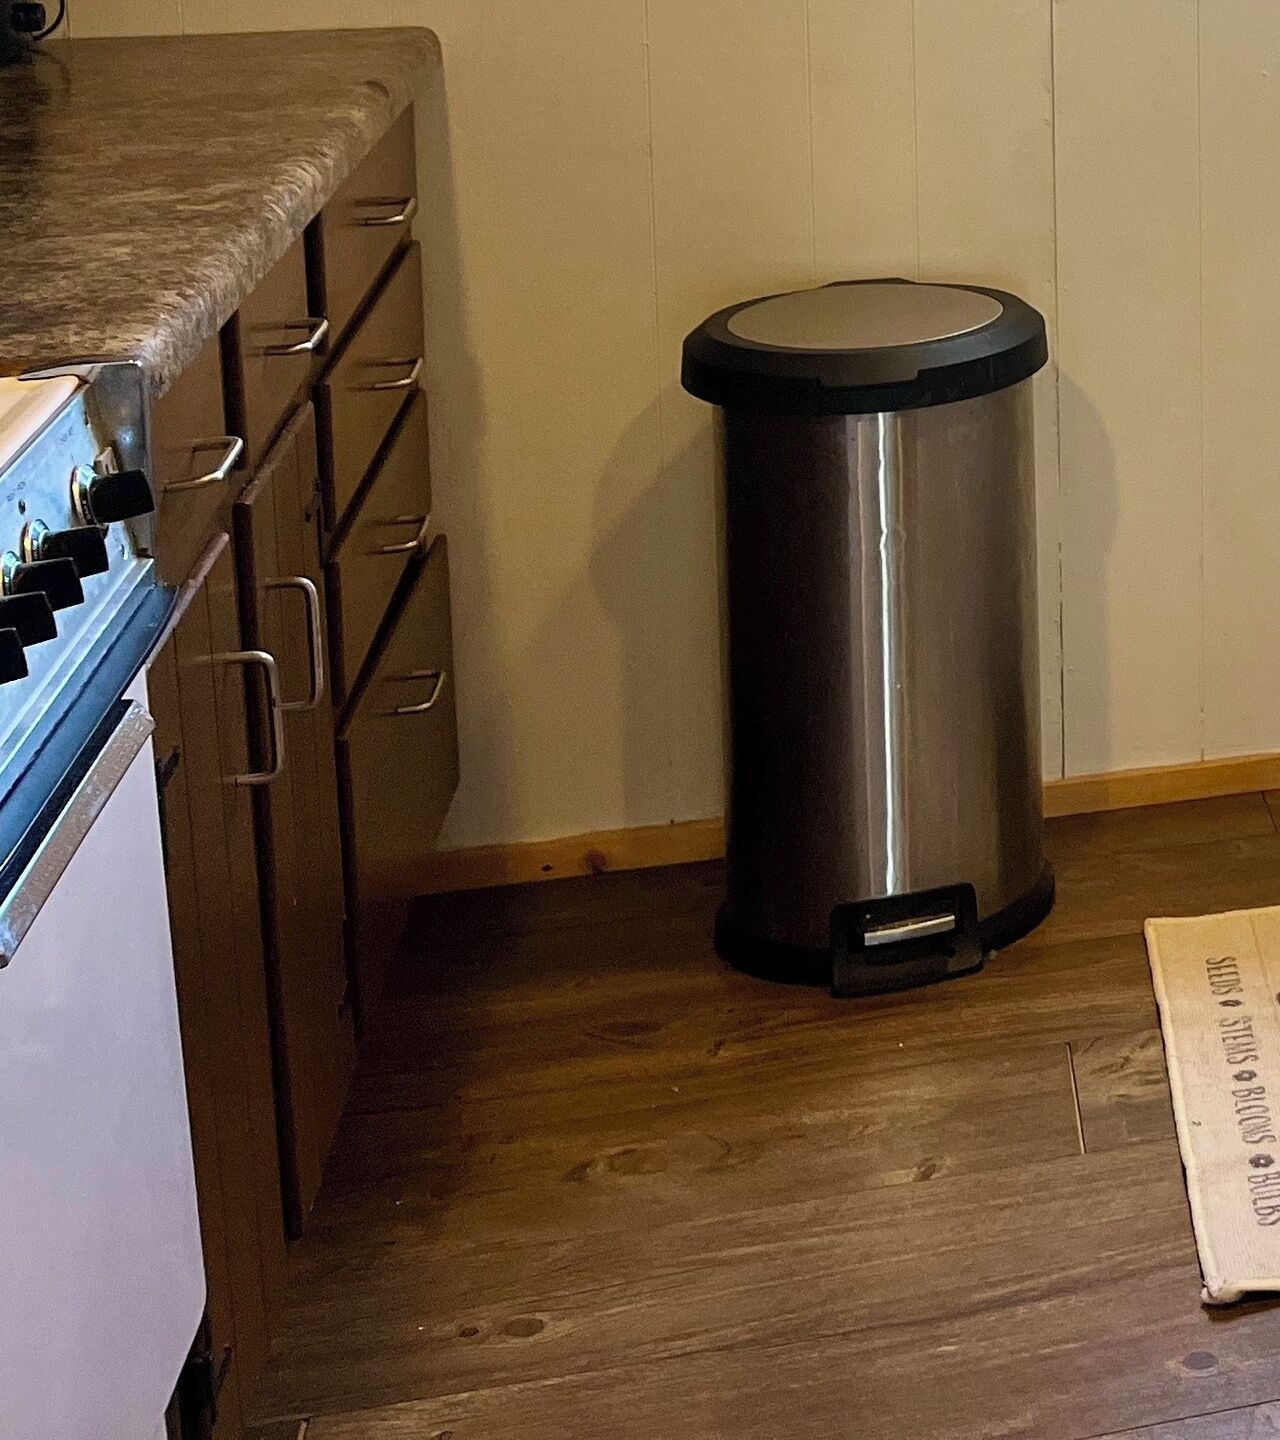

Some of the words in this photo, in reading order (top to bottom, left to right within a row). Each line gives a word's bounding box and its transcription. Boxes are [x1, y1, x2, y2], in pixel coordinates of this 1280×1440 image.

[1206, 956, 1244, 997] SEEDS
[1219, 1015, 1259, 1071] STEMS
[1232, 1087, 1277, 1148] BLOOMS
